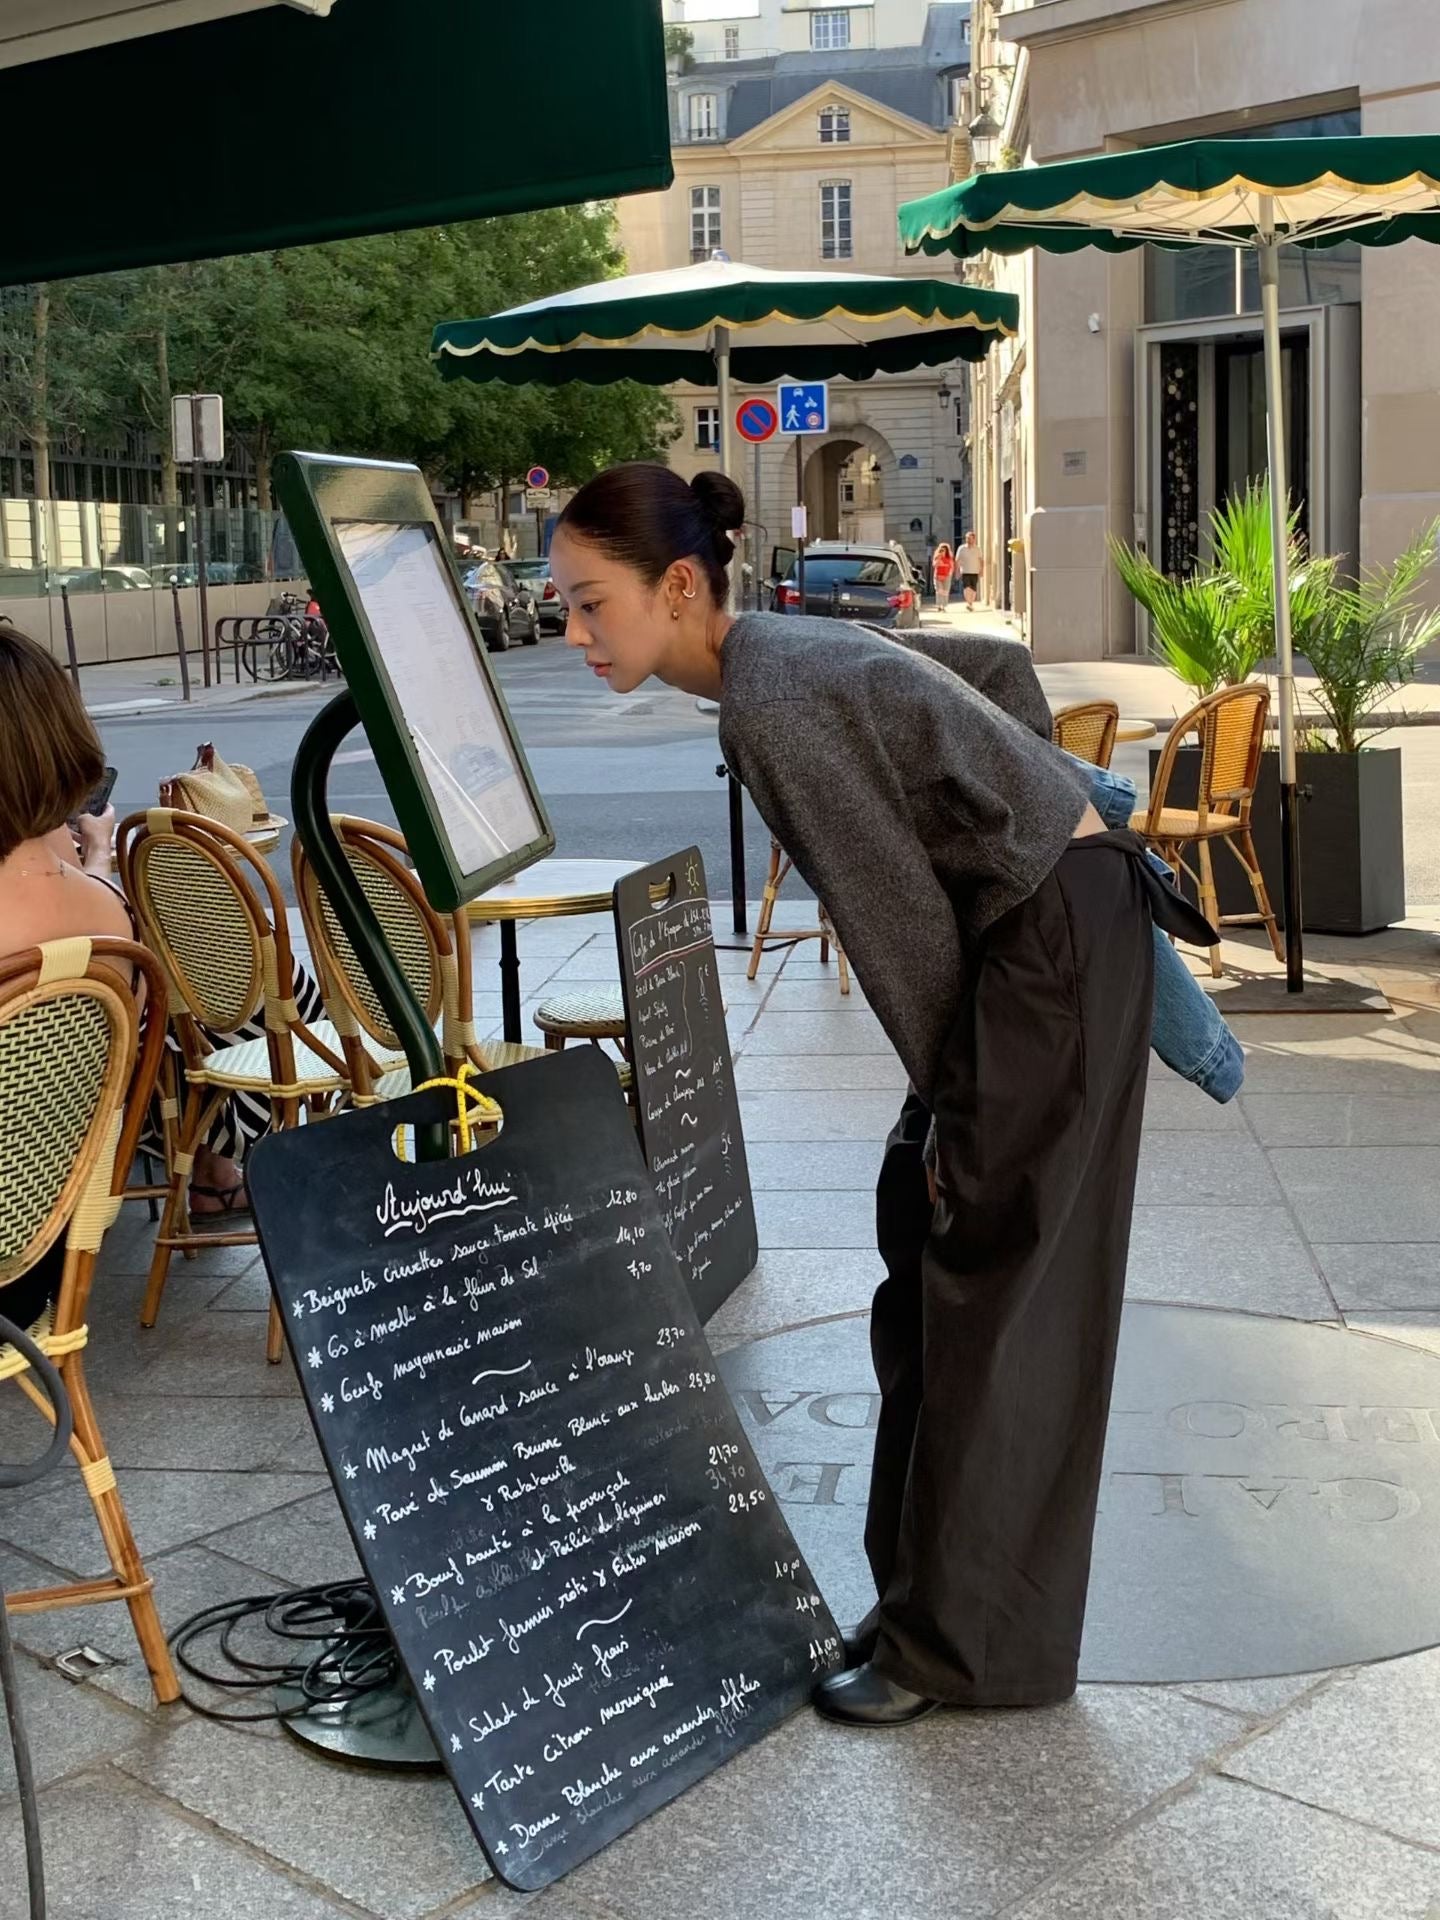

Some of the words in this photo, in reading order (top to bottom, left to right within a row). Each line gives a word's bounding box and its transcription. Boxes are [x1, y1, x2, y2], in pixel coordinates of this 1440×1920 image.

[303, 1269, 377, 1315] Beignets
[383, 1249, 444, 1283] crevettes
[450, 1238, 491, 1262] sauce
[493, 1215, 539, 1243] tomate
[606, 1189, 638, 1208] 12,80
[376, 1168, 511, 1234] Aujourd'hui
[353, 1329, 366, 1349] à
[422, 1295, 437, 1313] à
[441, 1285, 458, 1306] la
[463, 1276, 497, 1312] fleur
[500, 1266, 515, 1287] de
[521, 1255, 540, 1280] Sel
[615, 1225, 646, 1246] 14,10
[392, 1337, 472, 1381] mayonnaise
[476, 1317, 523, 1345] maison
[626, 1259, 653, 1280] 7,70
[365, 1430, 431, 1474] Magret
[437, 1418, 455, 1442] de
[459, 1394, 510, 1428] Canard
[516, 1381, 561, 1408] sauce
[567, 1362, 580, 1382] à
[585, 1345, 635, 1371] l'orange
[656, 1327, 686, 1348] 23,70
[375, 1491, 420, 1525] Pavé
[427, 1476, 450, 1504] de
[449, 1458, 508, 1490] Saumon
[512, 1436, 563, 1460] Beurre
[617, 1400, 640, 1417] aux
[643, 1379, 681, 1403] herbes
[688, 1372, 717, 1392] 25,80
[465, 1529, 512, 1567] sauté
[521, 1519, 534, 1537] à
[541, 1503, 561, 1524] la
[566, 1470, 631, 1523] provençale
[708, 1444, 739, 1466] 21,70
[497, 1454, 577, 1502] Ratatouille
[530, 1547, 546, 1571] et
[598, 1511, 613, 1534] de
[614, 1493, 666, 1526] légumes
[433, 1634, 495, 1675] Poulet
[498, 1596, 554, 1654] fermier
[558, 1576, 589, 1609] rôti
[728, 1488, 766, 1513] 22,50
[468, 1701, 519, 1743] Salade
[522, 1686, 541, 1711] de
[543, 1661, 585, 1708] fruit
[591, 1633, 630, 1678] frais
[774, 1558, 801, 1580] 10,00
[484, 1762, 536, 1794] Tarte
[542, 1725, 593, 1762] Citron
[795, 1592, 821, 1618] 11,00
[508, 1812, 561, 1849] Dame
[561, 1761, 623, 1807] Blanche
[629, 1744, 660, 1768] aux
[809, 1637, 838, 1660] 11,00
